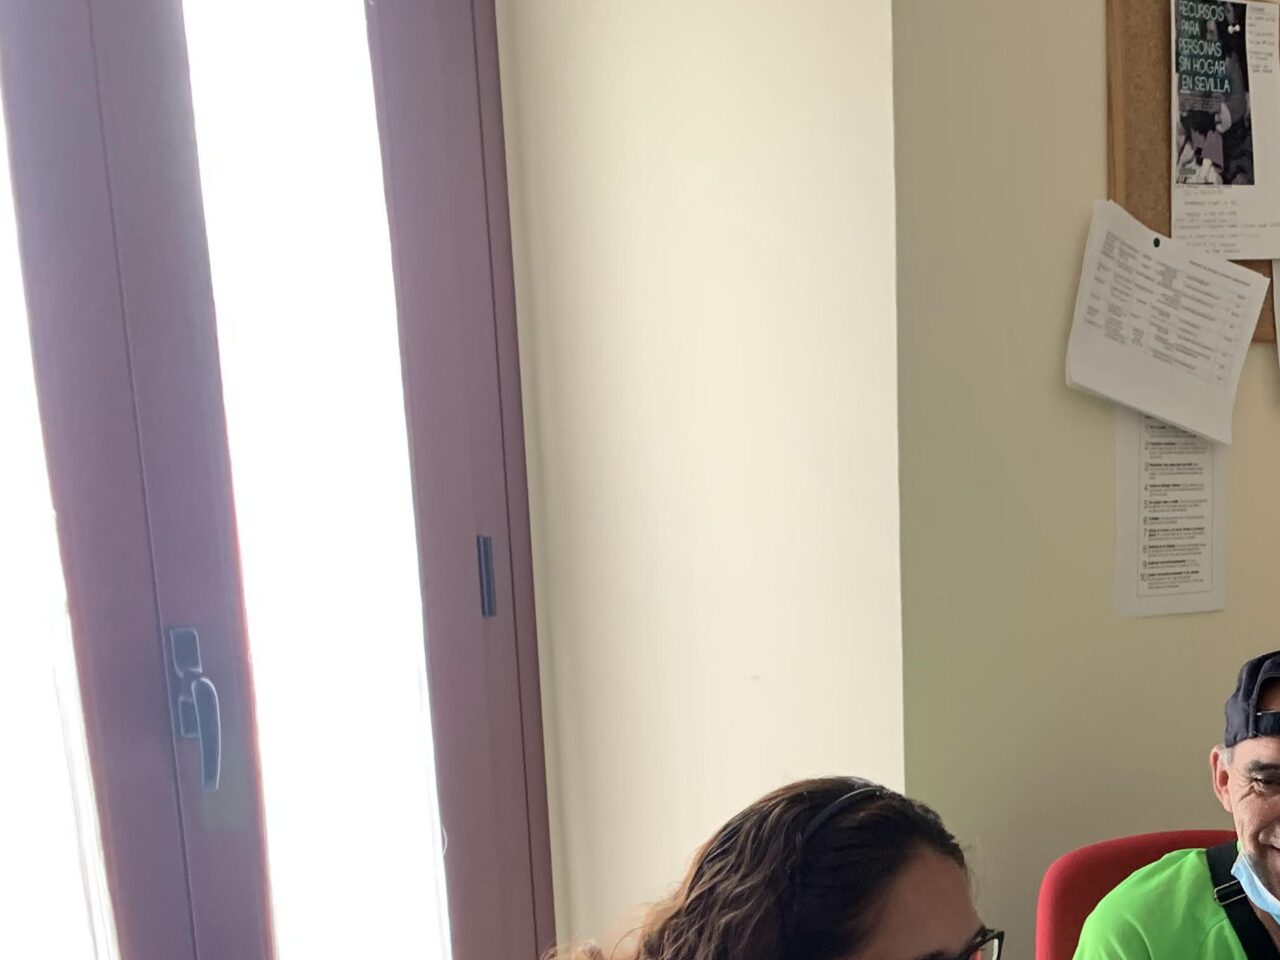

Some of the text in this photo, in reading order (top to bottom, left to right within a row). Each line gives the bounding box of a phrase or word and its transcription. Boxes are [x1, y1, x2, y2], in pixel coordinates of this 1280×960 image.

[1180, 1, 1225, 21] RECURSOS
[1181, 19, 1200, 36] PARA
[1179, 37, 1222, 57] PERSONAS
[1179, 55, 1226, 75] SIN HOGAR
[1182, 75, 1231, 93] EN SEVILLA
